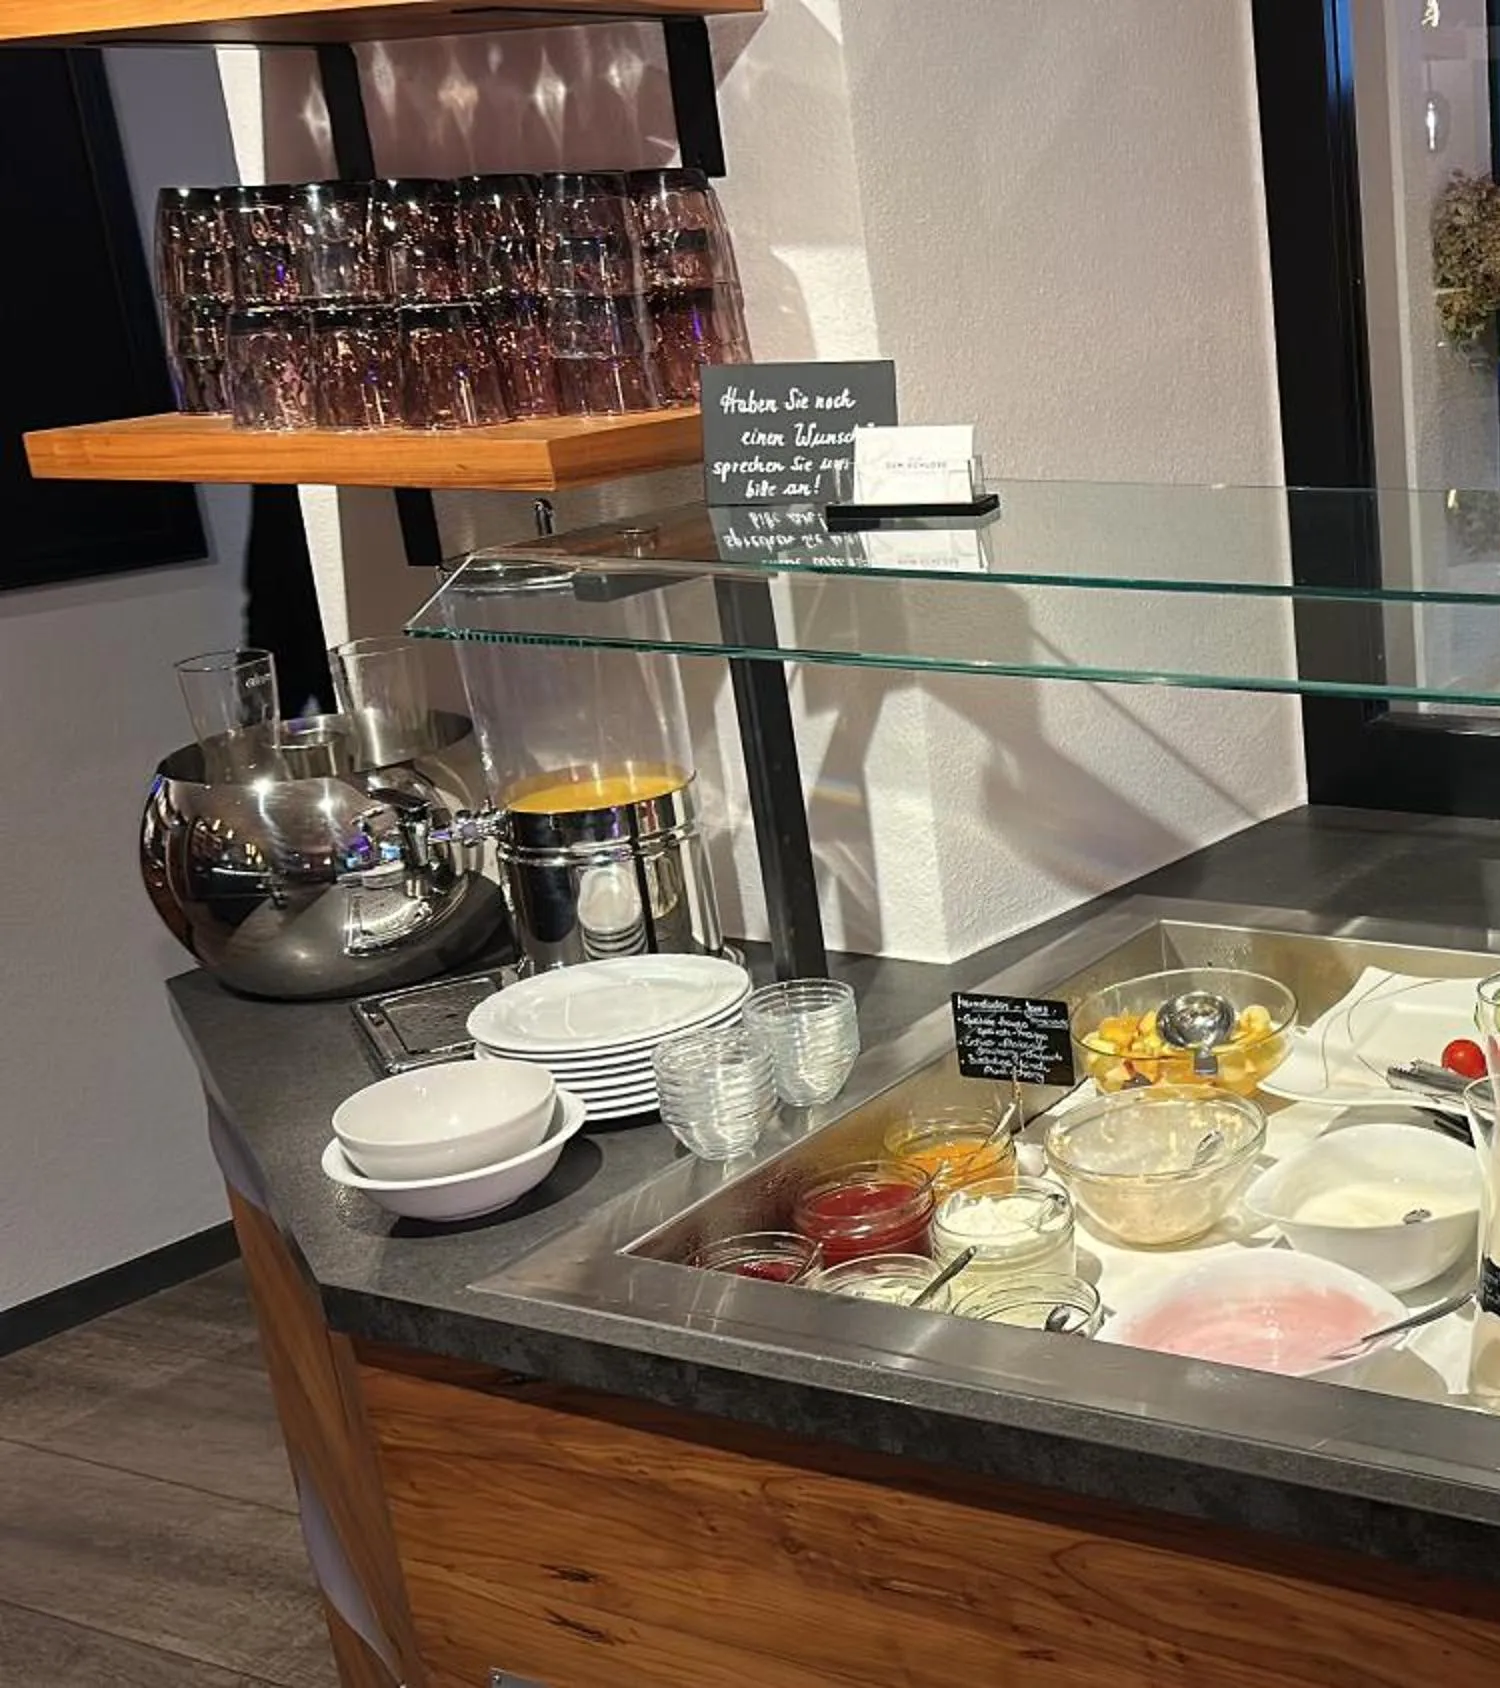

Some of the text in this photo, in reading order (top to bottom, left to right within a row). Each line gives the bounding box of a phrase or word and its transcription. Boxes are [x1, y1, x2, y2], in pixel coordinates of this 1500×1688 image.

[720, 386, 856, 414] Haben Sie noch
[741, 427, 784, 446] einen
[712, 455, 785, 483] sprechen
[790, 455, 813, 472] Sie
